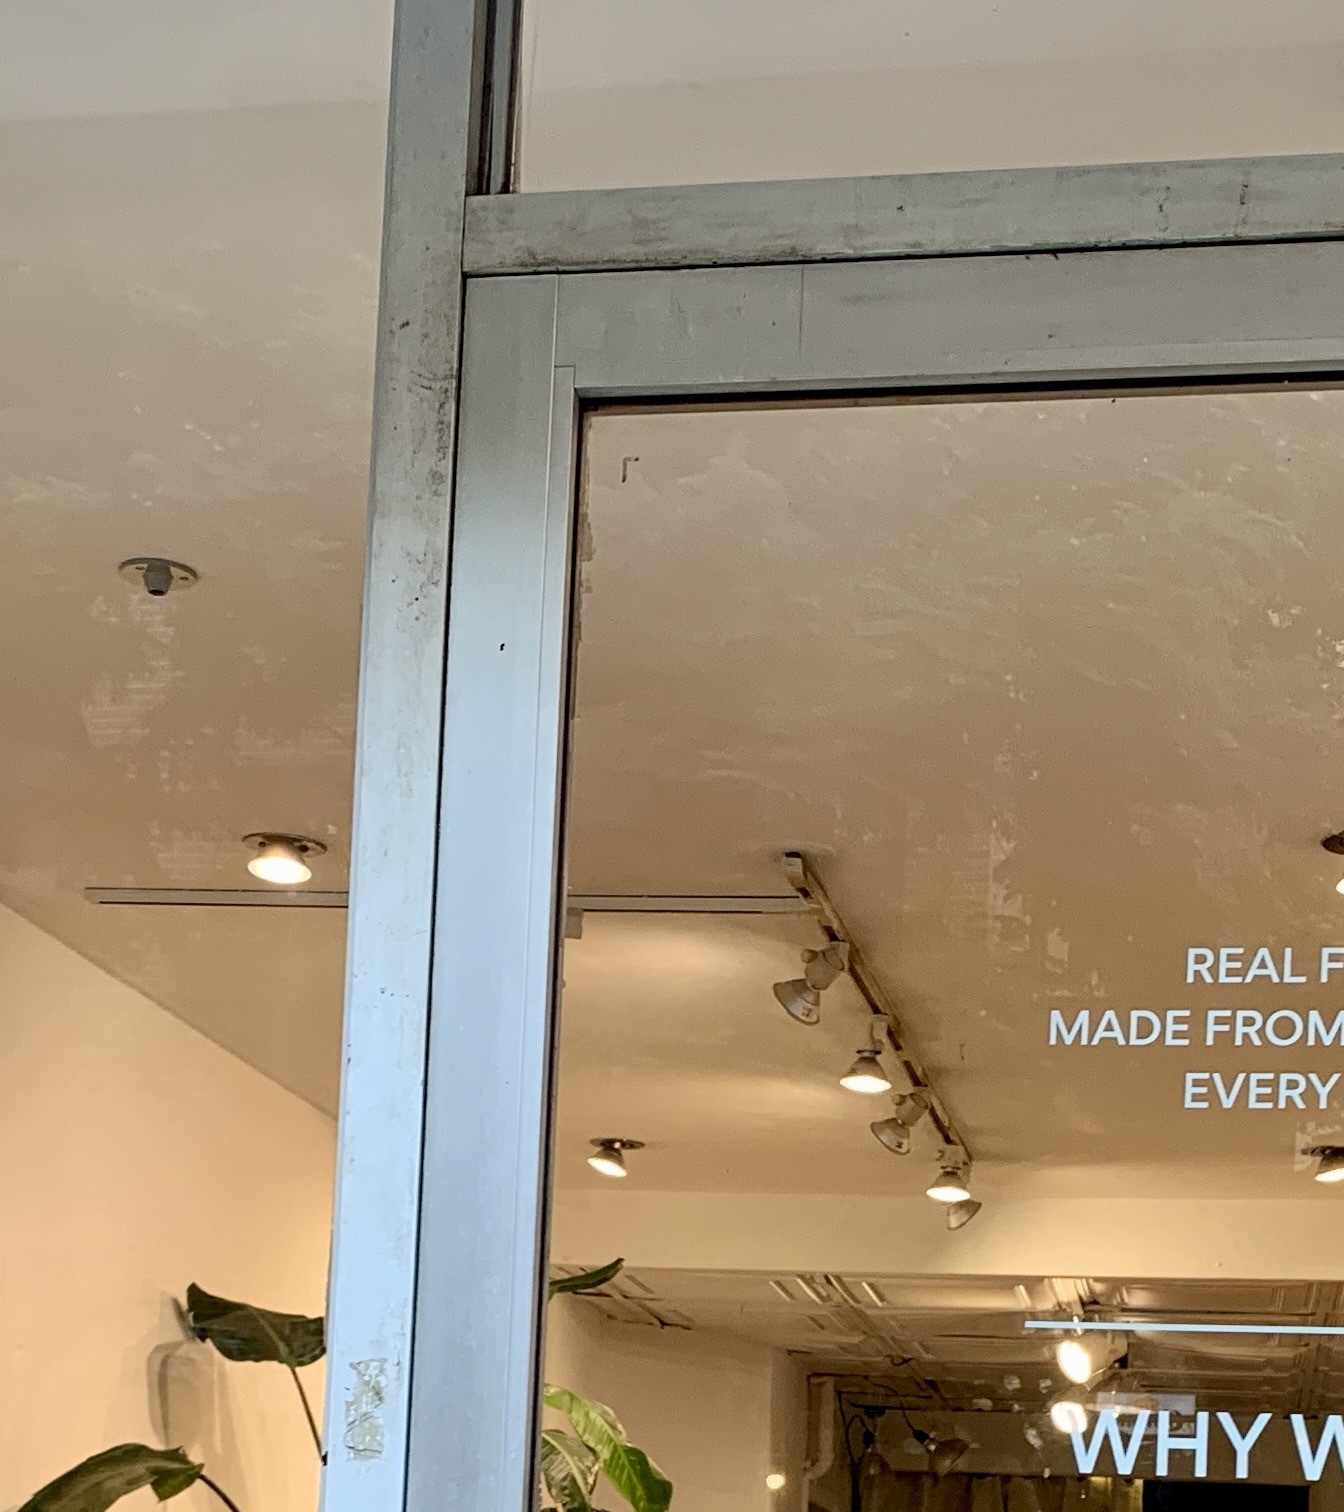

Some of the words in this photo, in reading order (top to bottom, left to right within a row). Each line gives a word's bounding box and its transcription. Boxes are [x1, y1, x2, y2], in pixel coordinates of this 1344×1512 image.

[1185, 947, 1306, 984] REAL
[1050, 1010, 1188, 1046] MADE
[1184, 1072, 1337, 1109] EVERY
[1070, 1409, 1272, 1480] WHY
